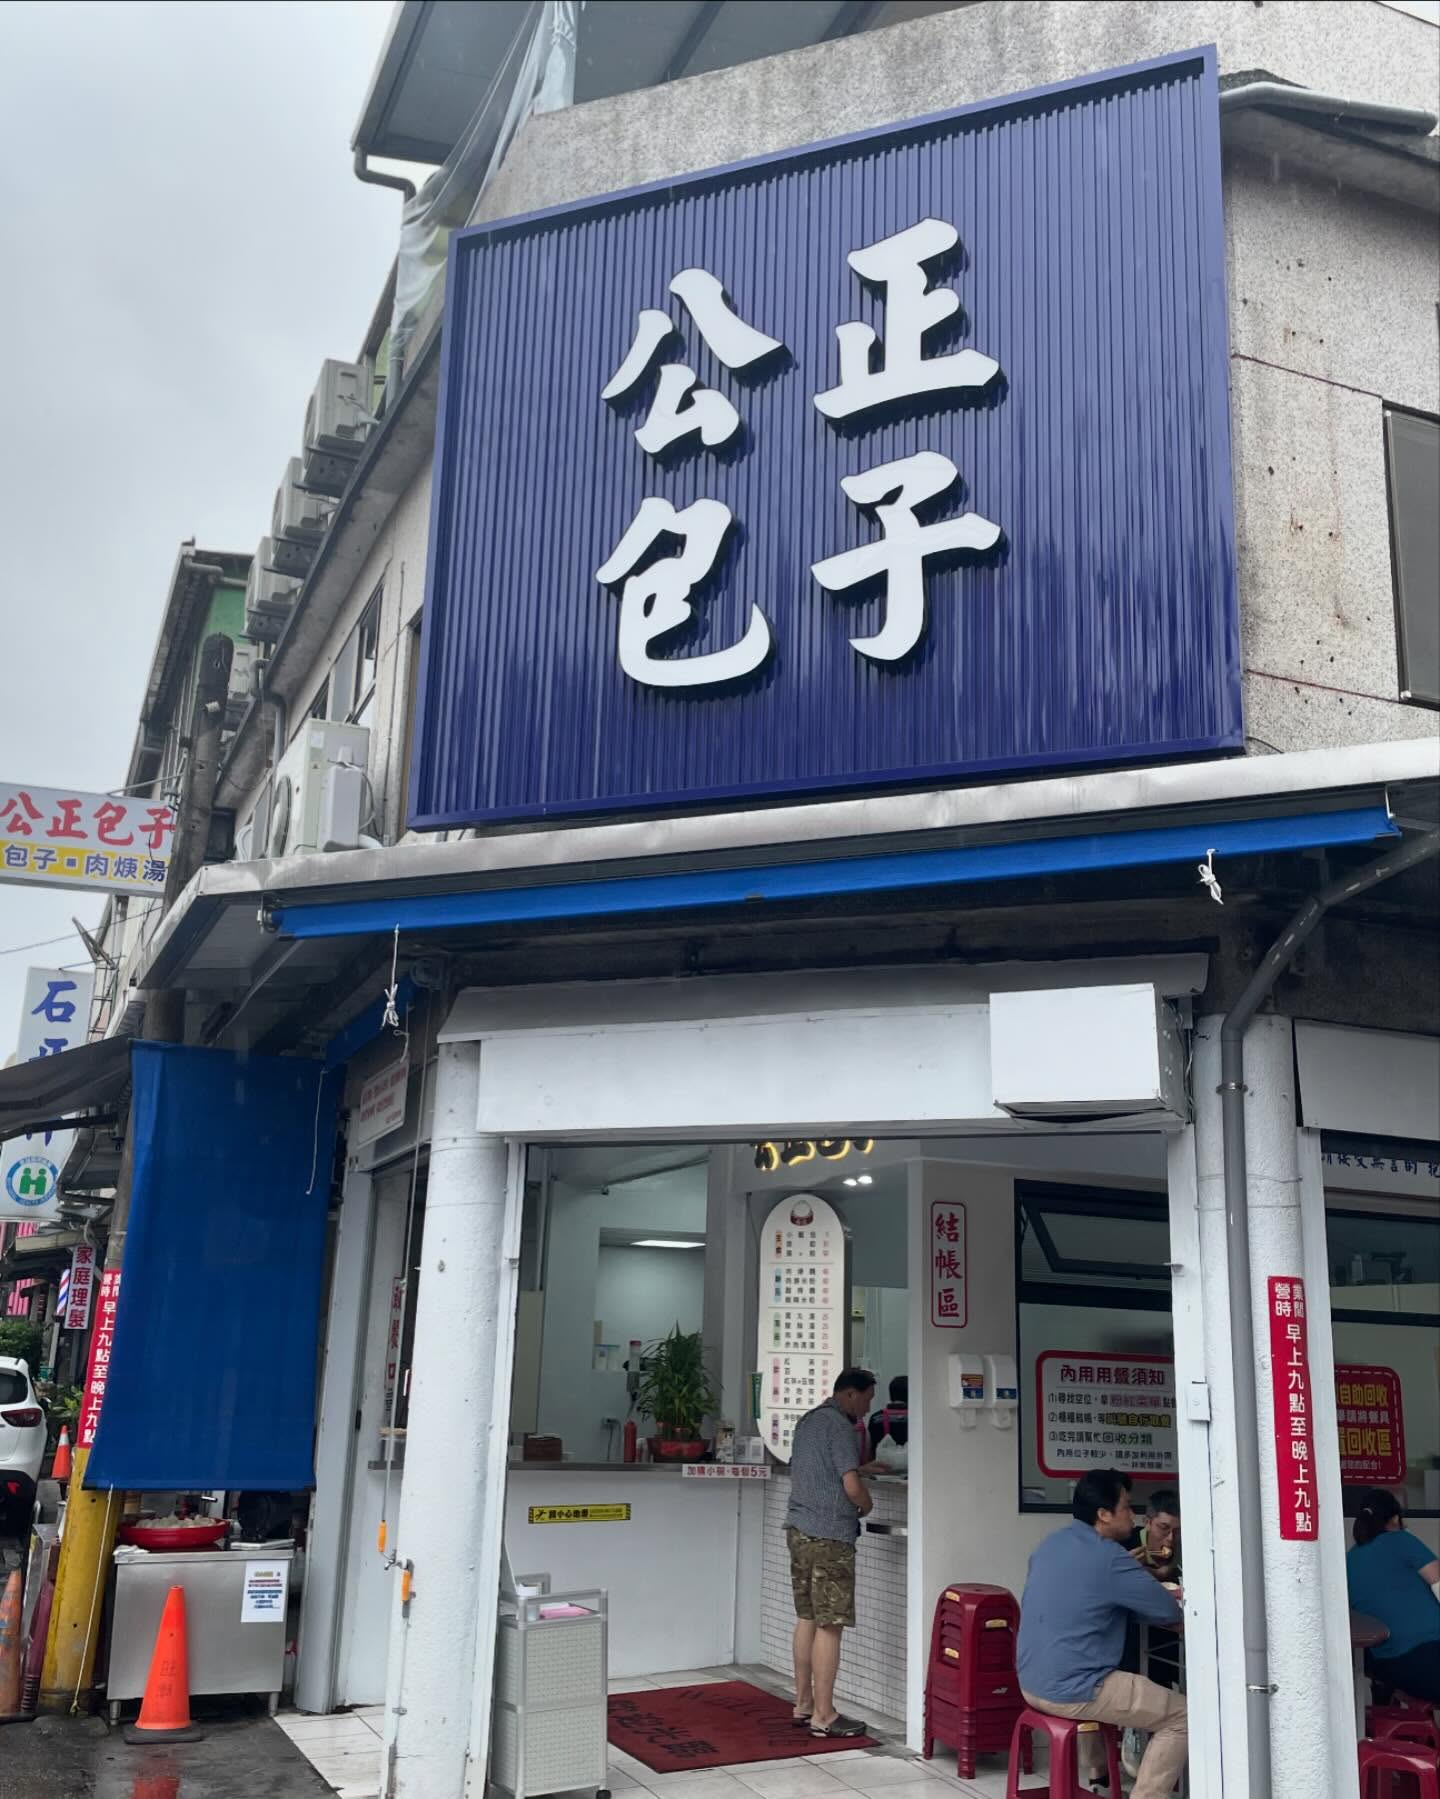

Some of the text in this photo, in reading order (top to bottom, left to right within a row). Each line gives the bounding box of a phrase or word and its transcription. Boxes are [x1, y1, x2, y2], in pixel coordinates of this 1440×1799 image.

[601, 217, 1000, 454] 公正
[596, 450, 1001, 686] 包子
[0, 792, 176, 849] 公正包子
[67, 1246, 93, 1329] 家庭理髮
[935, 1212, 962, 1317] 結帳區
[1061, 1365, 1165, 1385] 內用用餐須知
[1337, 1383, 1389, 1407] 自助回收
[1286, 1324, 1312, 1532] 早上九點至晚上九點
